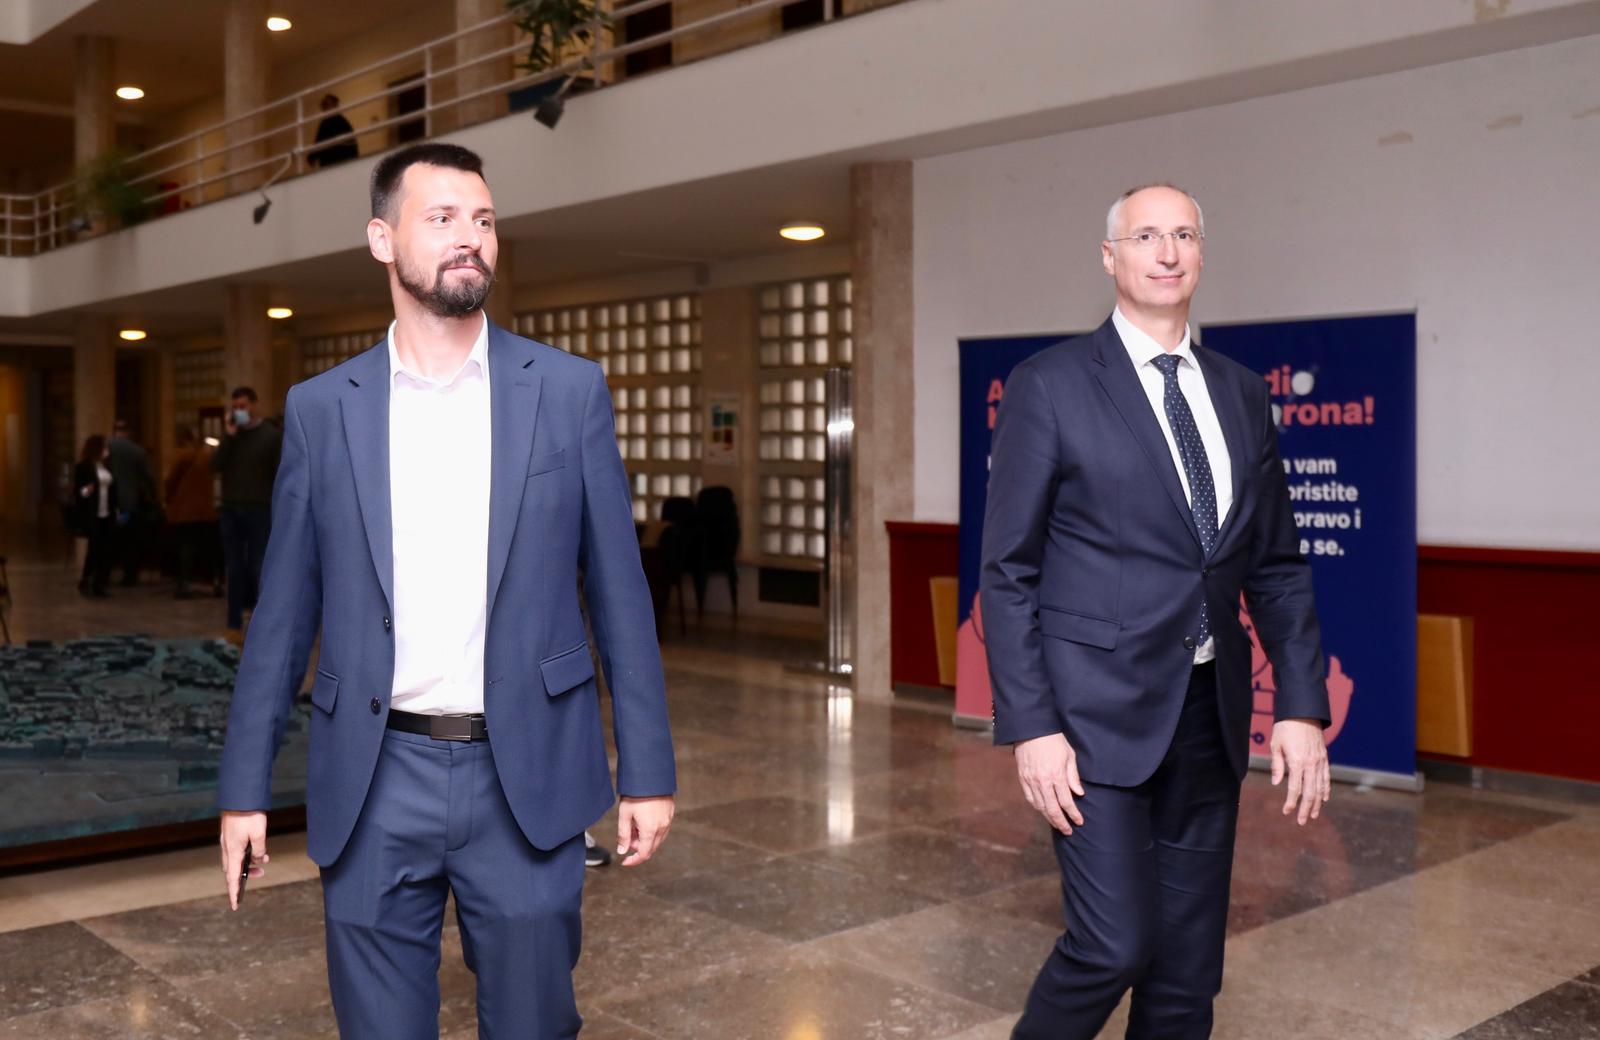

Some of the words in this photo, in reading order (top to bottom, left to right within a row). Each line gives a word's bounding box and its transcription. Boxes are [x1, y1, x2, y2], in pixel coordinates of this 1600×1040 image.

[1294, 458, 1337, 475] vam
[1354, 508, 1362, 530] i
[1313, 539, 1345, 556] se.
